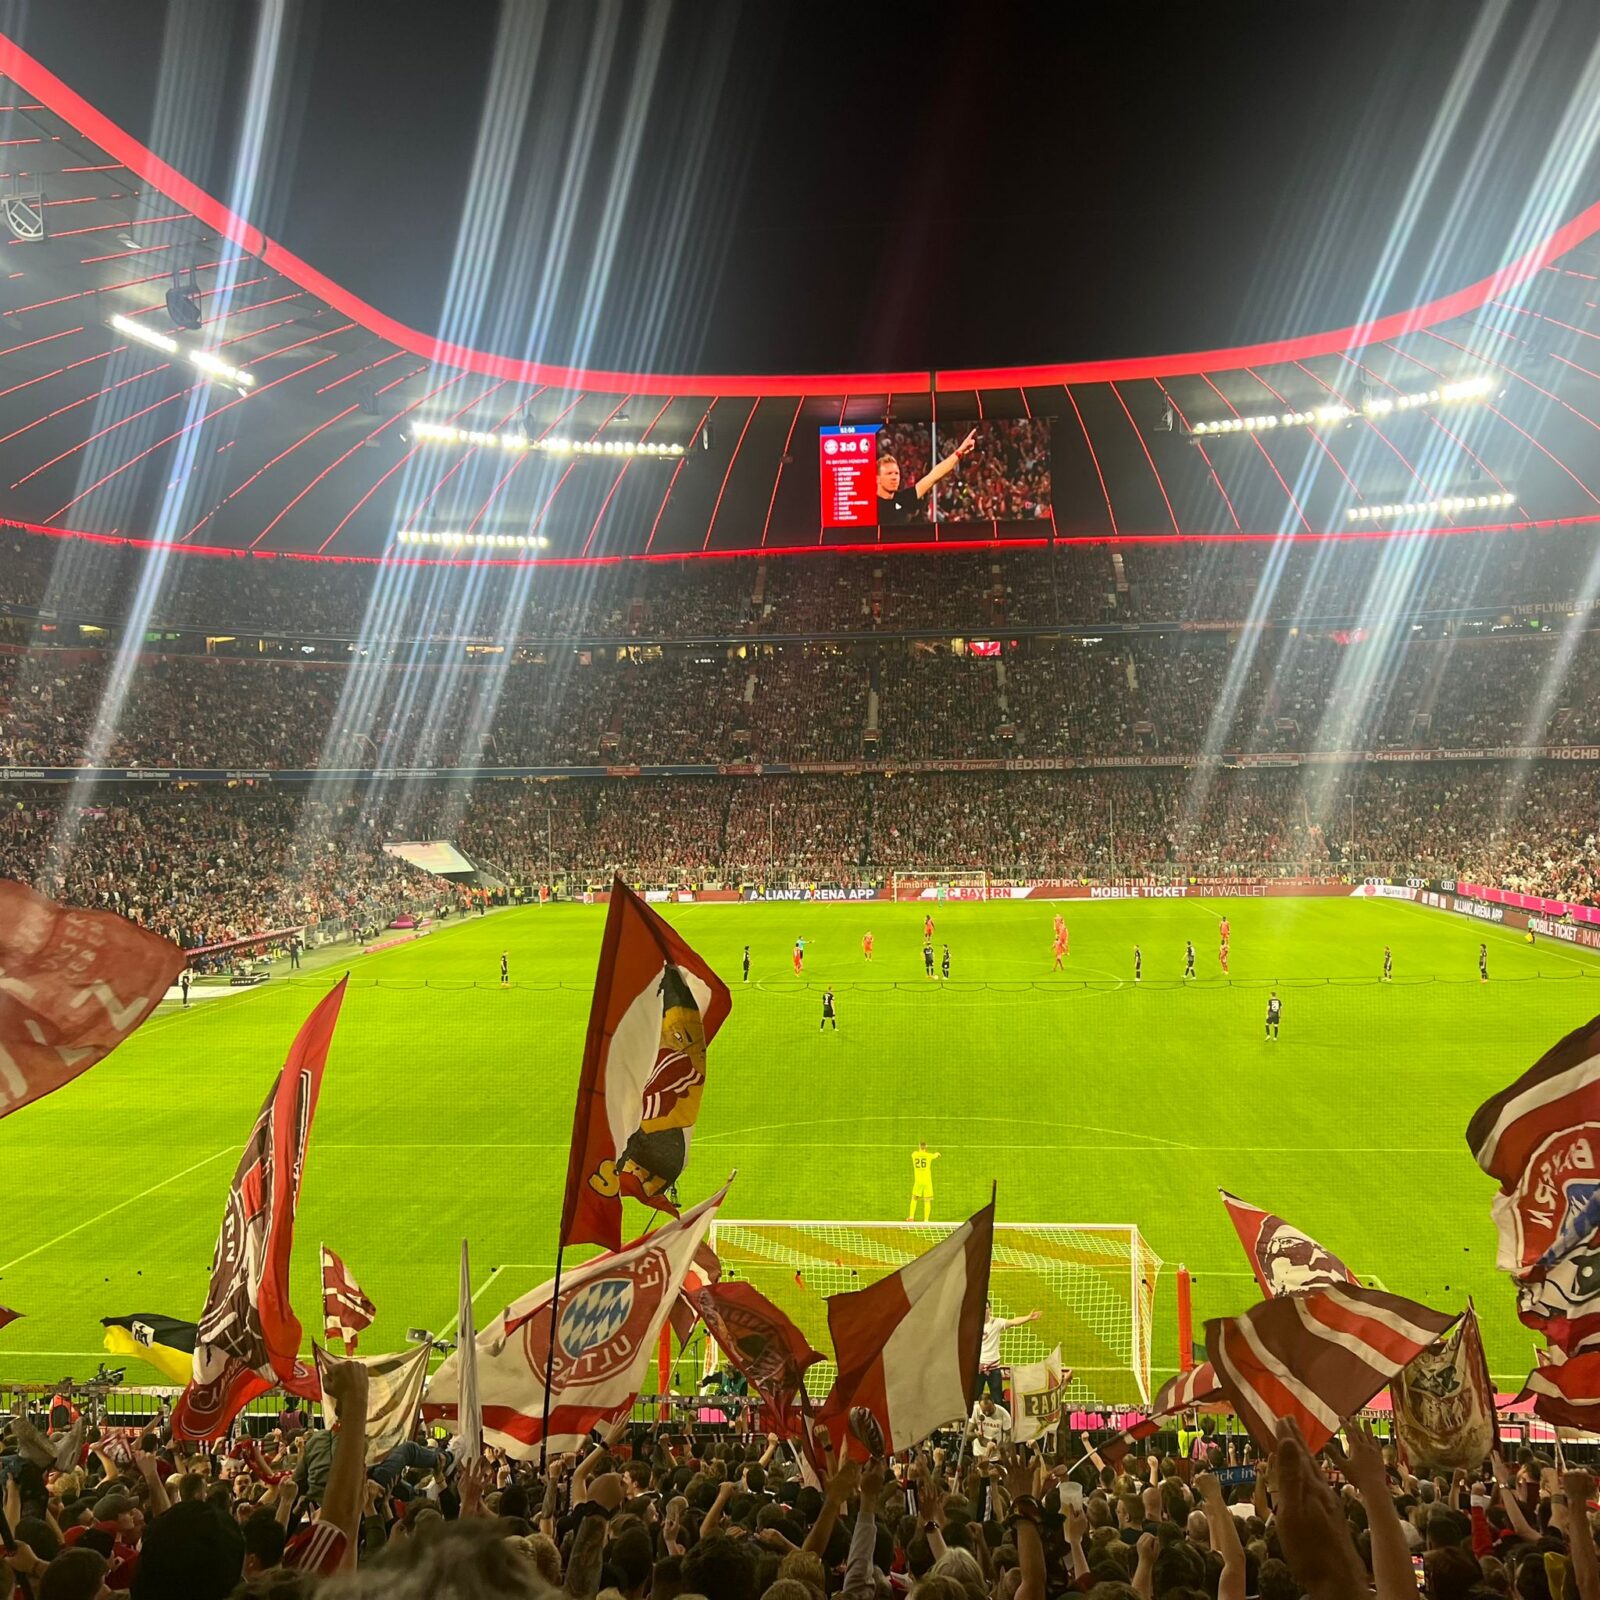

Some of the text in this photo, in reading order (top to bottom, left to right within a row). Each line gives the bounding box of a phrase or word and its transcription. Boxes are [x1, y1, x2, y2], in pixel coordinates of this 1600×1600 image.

[840, 441, 857, 452] 3:0
[1535, 602, 1573, 614] FLYING
[1093, 756, 1142, 766] NABBURG
[1375, 751, 1431, 761] Geisenfeld
[1006, 759, 1064, 770] REDSIDE
[803, 889, 847, 900] ARENA
[849, 889, 875, 900] APP
[1090, 887, 1140, 898] MOBILE
[1142, 886, 1188, 897] TICKET
[1199, 886, 1214, 897] IM
[1217, 885, 1268, 897] WALLET
[1453, 899, 1503, 921] ALLIANZ ARENA APP
[1554, 922, 1578, 942] TICKET
[914, 1158, 927, 1169] 26
